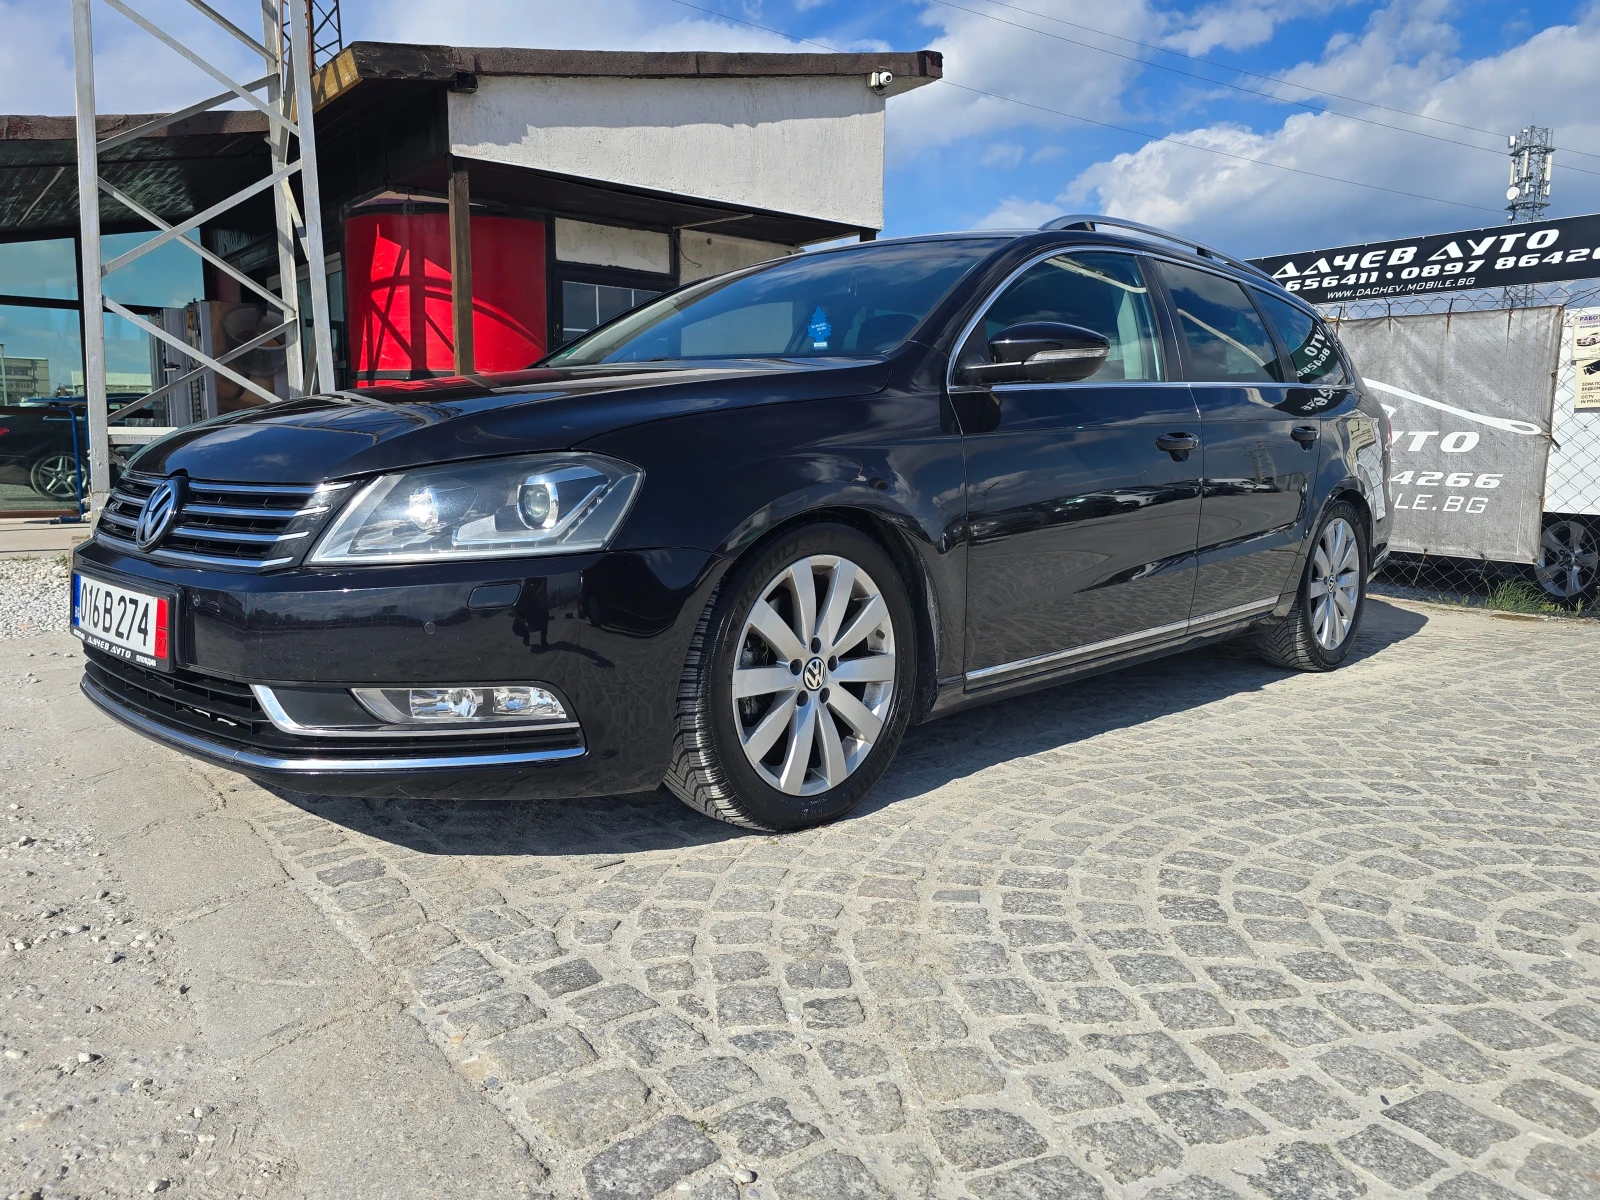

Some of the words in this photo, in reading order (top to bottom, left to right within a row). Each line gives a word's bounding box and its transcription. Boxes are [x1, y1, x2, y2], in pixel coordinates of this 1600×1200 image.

[1272, 246, 1417, 280] ДАЧЕВ
[1285, 270, 1378, 292] 656411
[1401, 259, 1486, 280] 0897
[1327, 277, 1476, 300] WWW.DACHEV.MOBILE.BG
[1390, 470, 1504, 489] 4266
